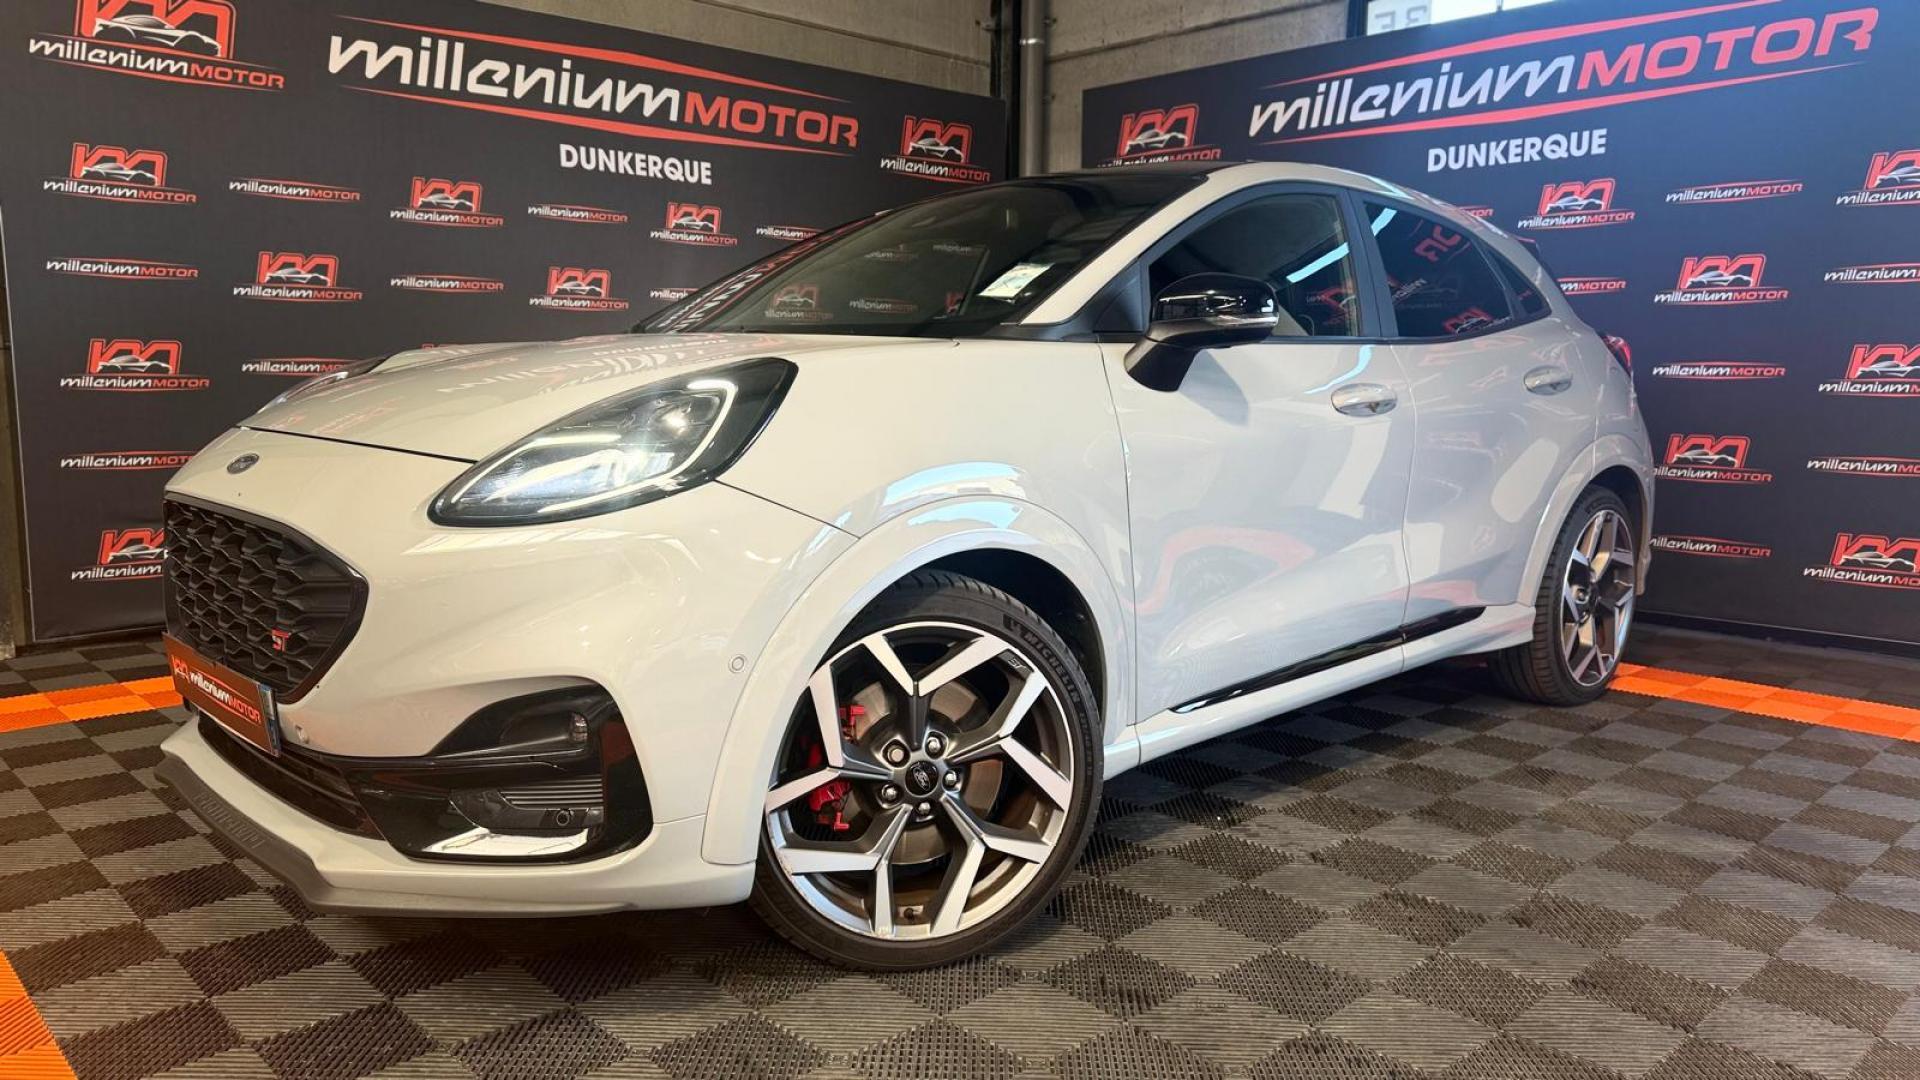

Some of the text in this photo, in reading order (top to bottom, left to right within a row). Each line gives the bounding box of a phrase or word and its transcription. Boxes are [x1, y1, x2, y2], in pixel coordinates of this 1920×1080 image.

[559, 143, 713, 186] DUNKERQUE
[1428, 128, 1607, 173] DUNKERQUE
[1824, 267, 1920, 281] millenium
